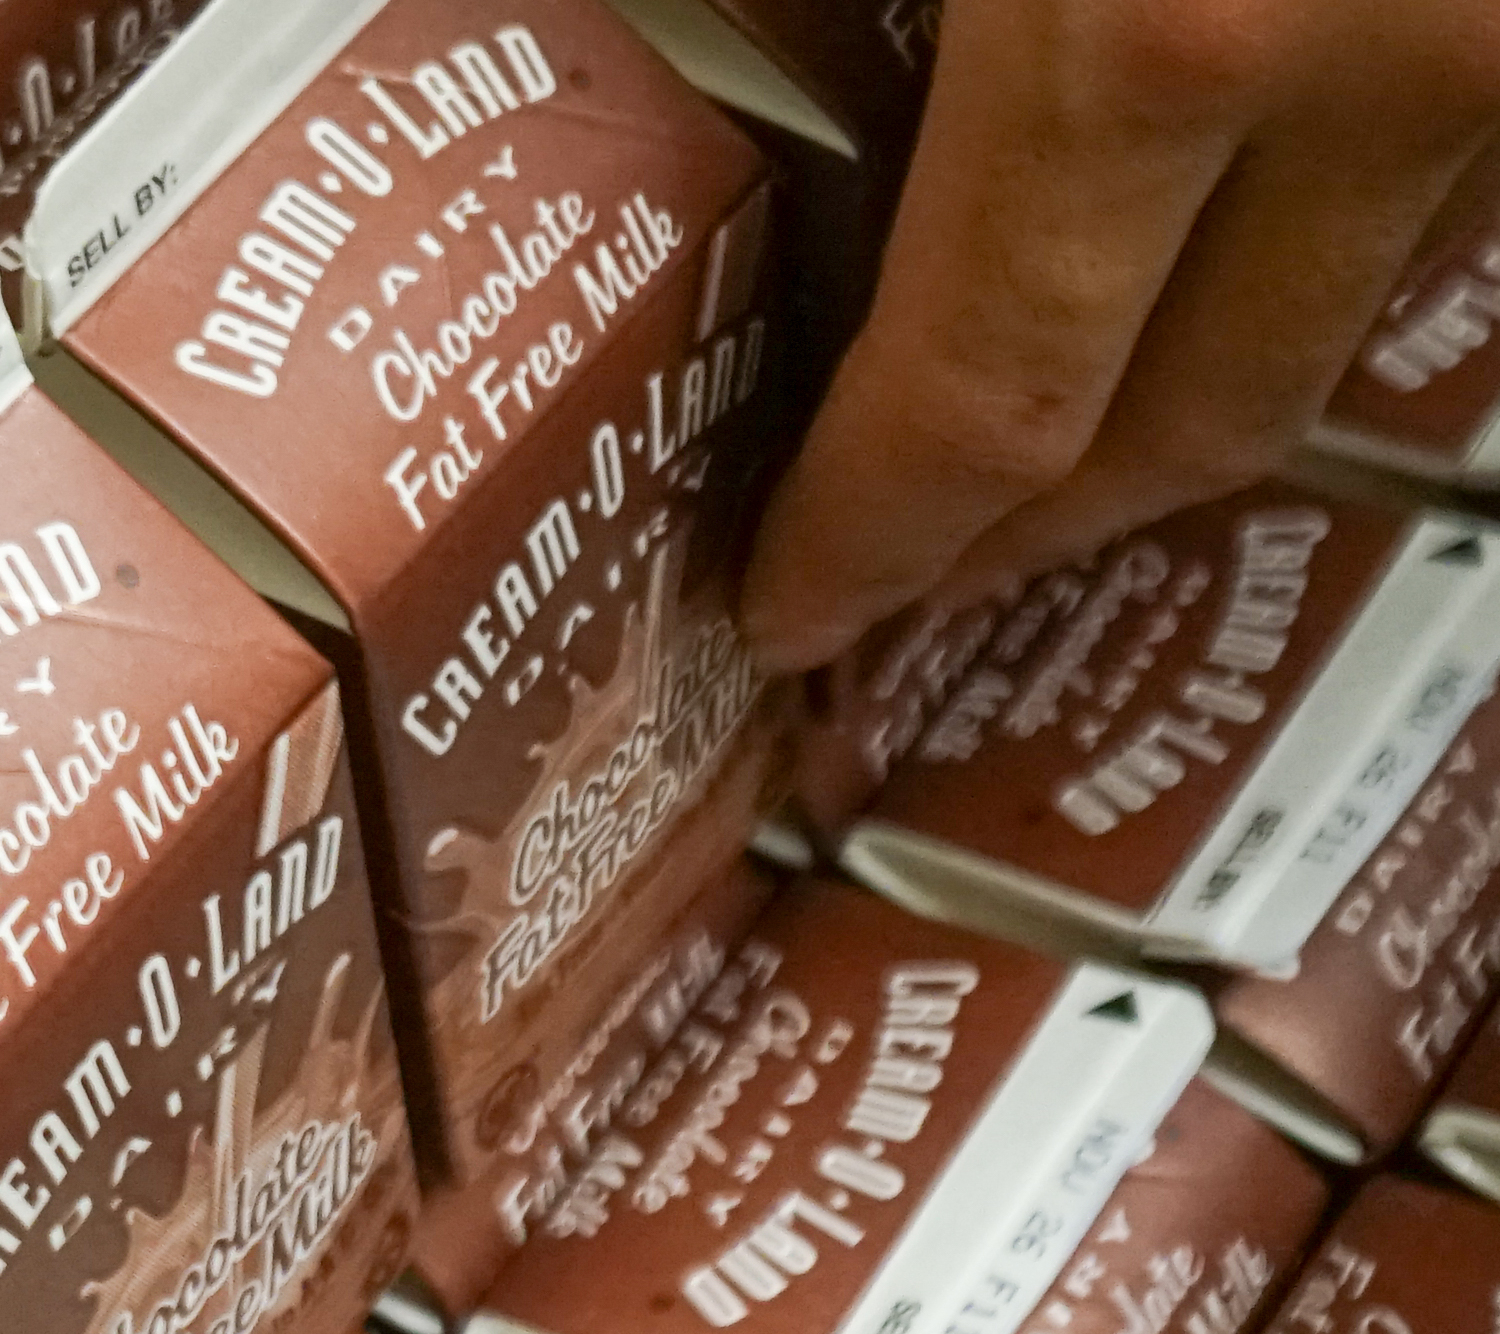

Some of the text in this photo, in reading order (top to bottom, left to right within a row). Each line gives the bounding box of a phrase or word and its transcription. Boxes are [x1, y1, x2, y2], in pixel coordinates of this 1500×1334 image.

[66, 161, 180, 290] SELL BY:
[370, 187, 597, 427] Chocolate
[386, 192, 686, 534] Fat Free Milk
[0, 850, 126, 990] Free
[113, 702, 240, 855] Milk
